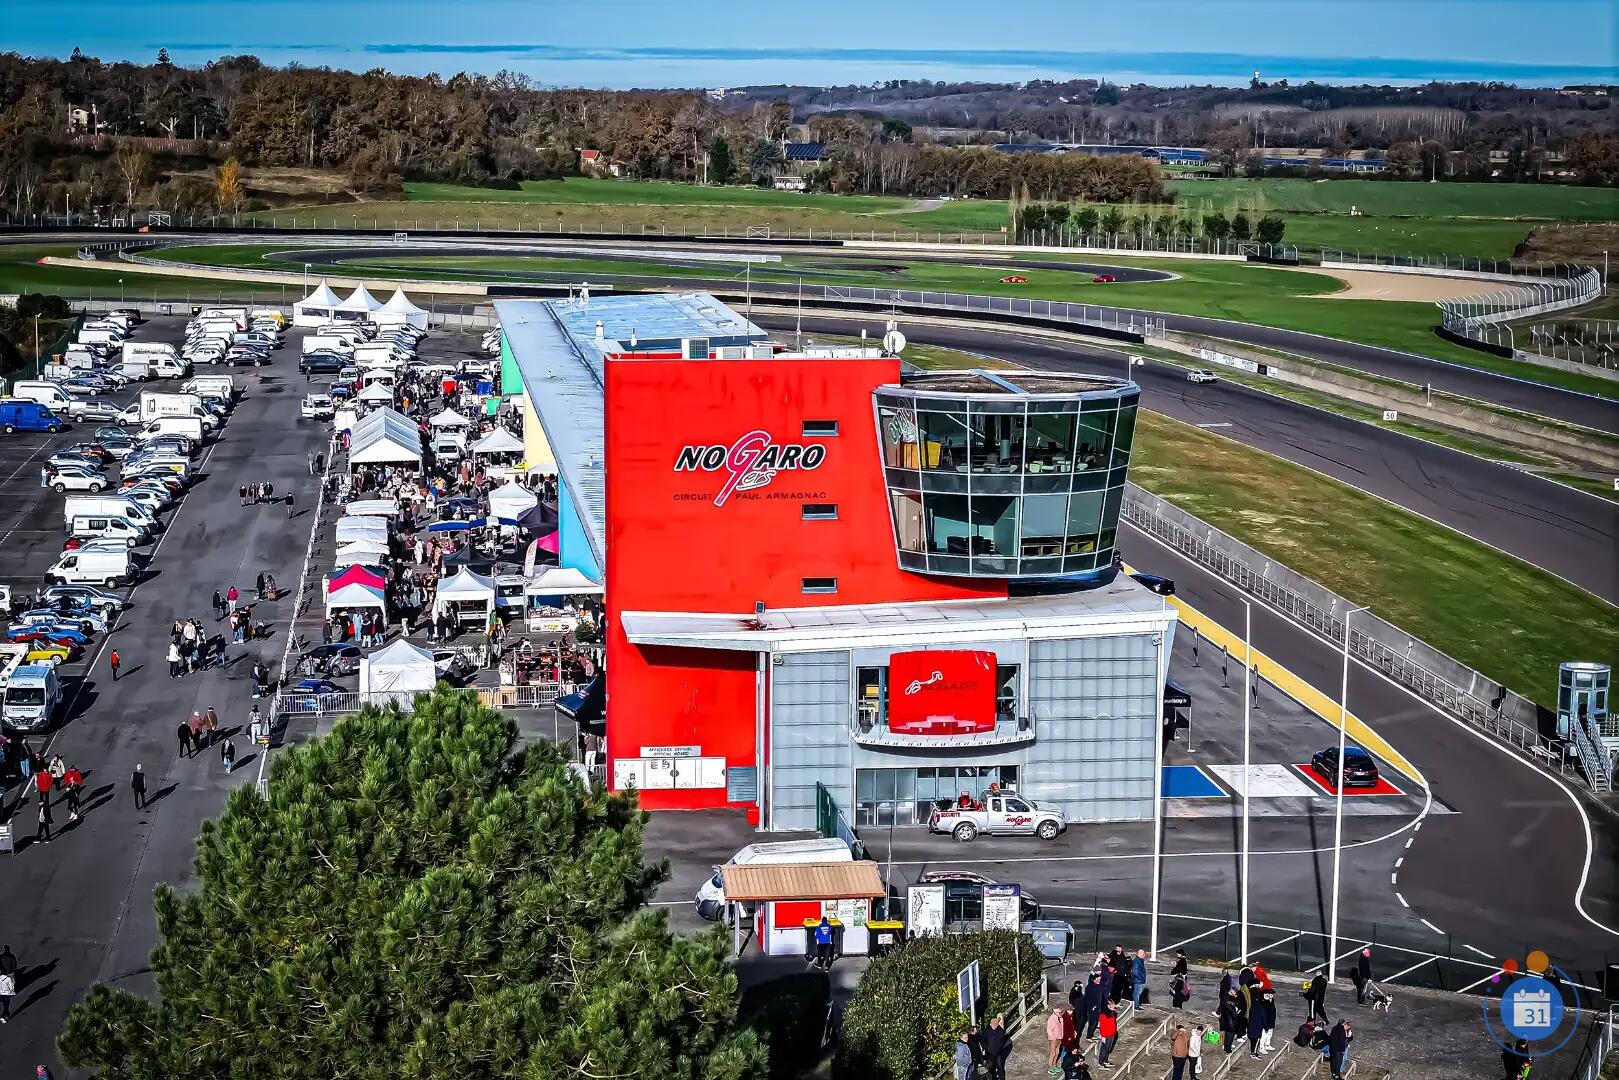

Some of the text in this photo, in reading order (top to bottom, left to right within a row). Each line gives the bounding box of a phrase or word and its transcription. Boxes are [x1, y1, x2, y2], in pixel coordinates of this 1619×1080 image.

[1386, 412, 1395, 420] 50
[673, 430, 827, 507] NOGARO
[673, 493, 713, 501] CIRCUIT
[766, 492, 827, 500] ARMAGNAC
